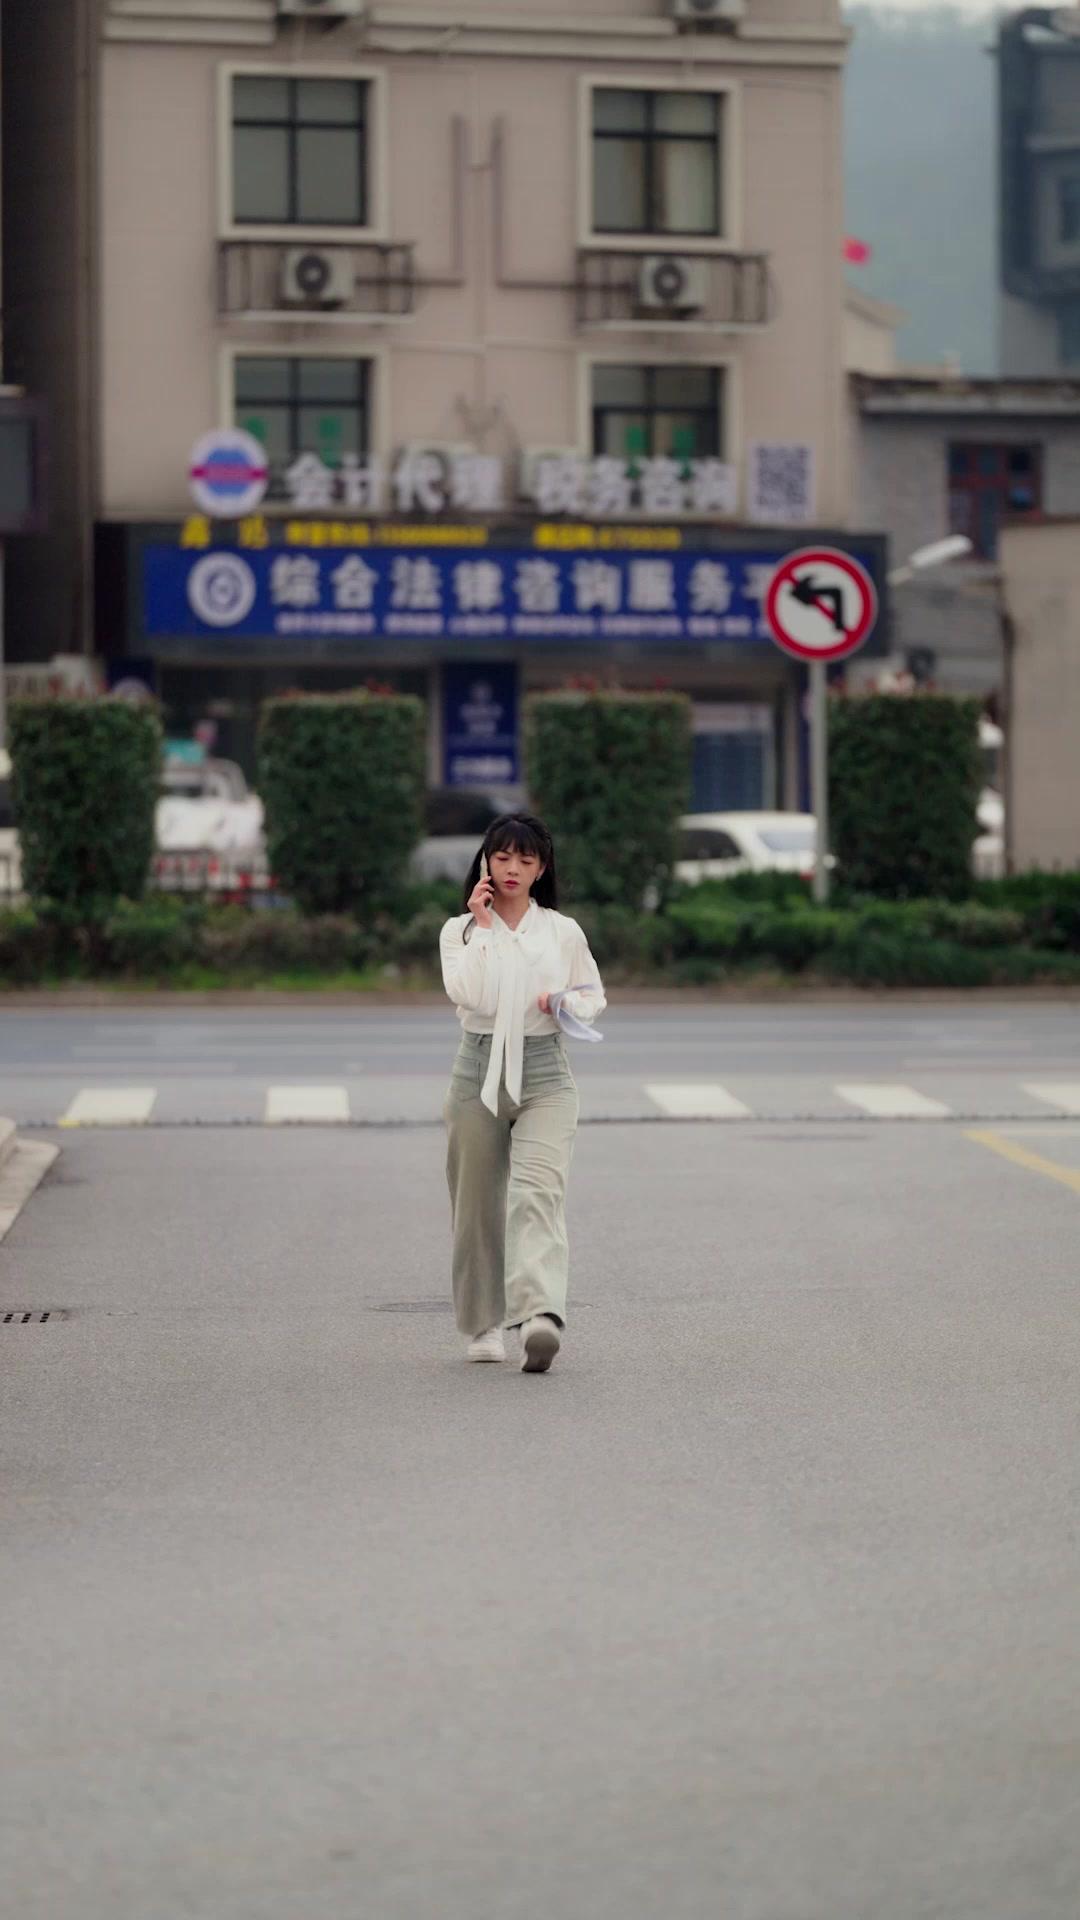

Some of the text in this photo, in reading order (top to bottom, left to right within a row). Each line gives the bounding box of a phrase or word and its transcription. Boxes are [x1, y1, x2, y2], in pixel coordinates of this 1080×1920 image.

[288, 450, 738, 514] 会计代理 税务咨询
